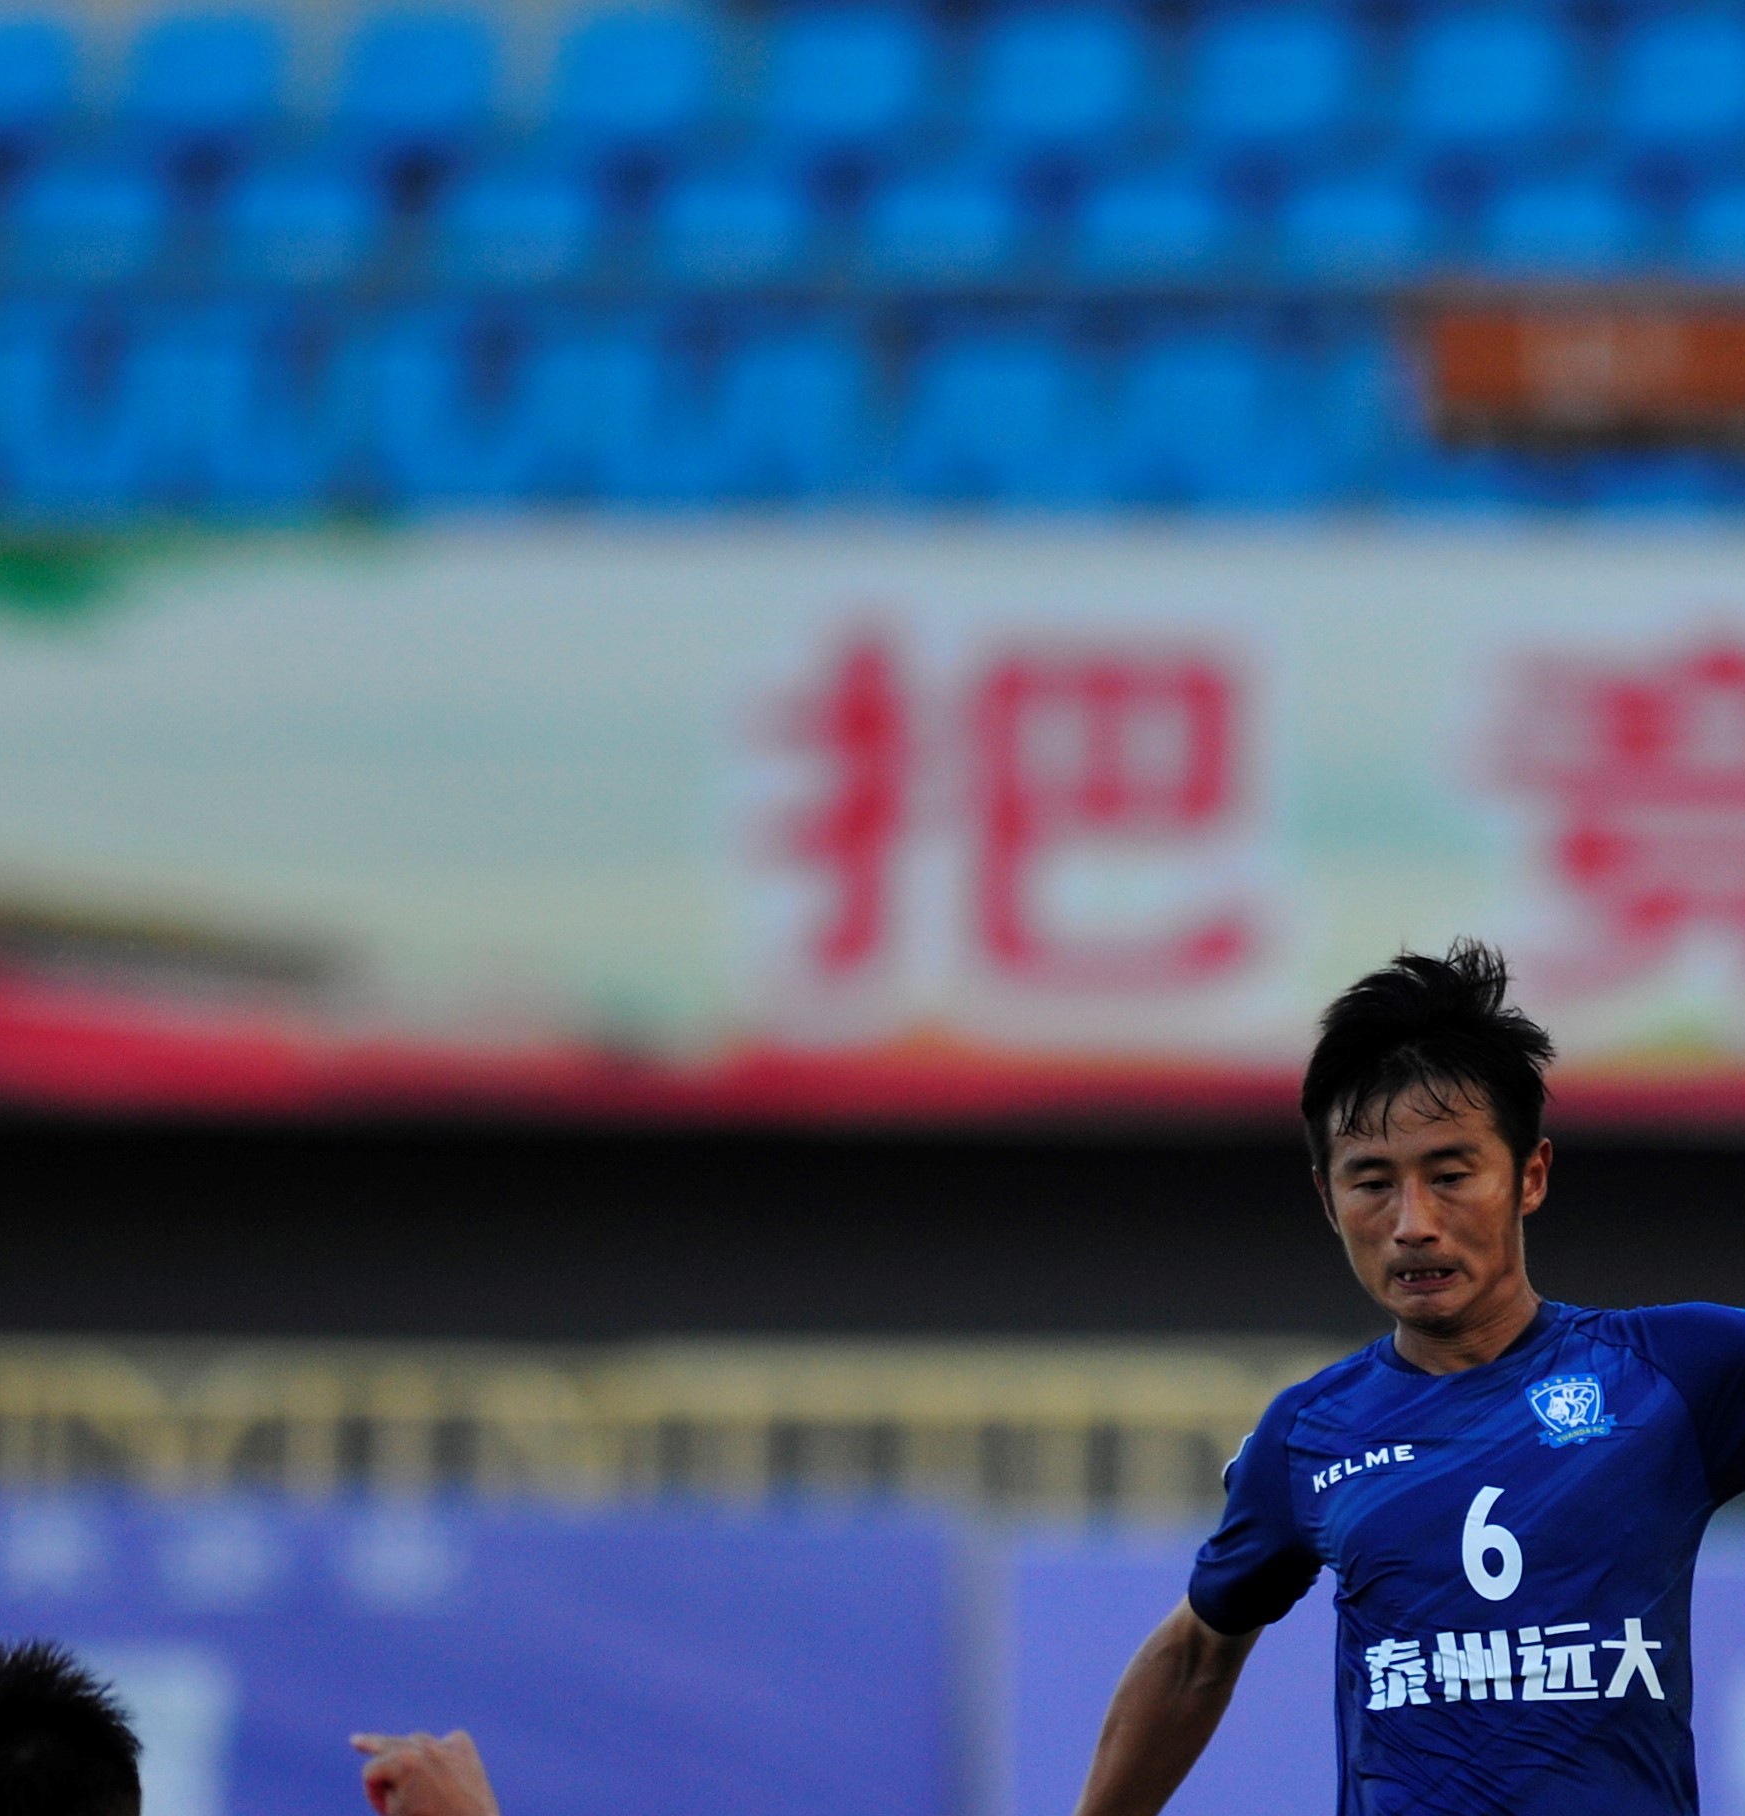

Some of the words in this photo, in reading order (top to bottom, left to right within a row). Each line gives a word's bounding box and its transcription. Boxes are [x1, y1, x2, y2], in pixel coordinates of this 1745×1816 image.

[1312, 1443, 1415, 1494] KELME
[1461, 1485, 1523, 1601] 6
[1364, 1617, 1666, 1711] 泰州远大
